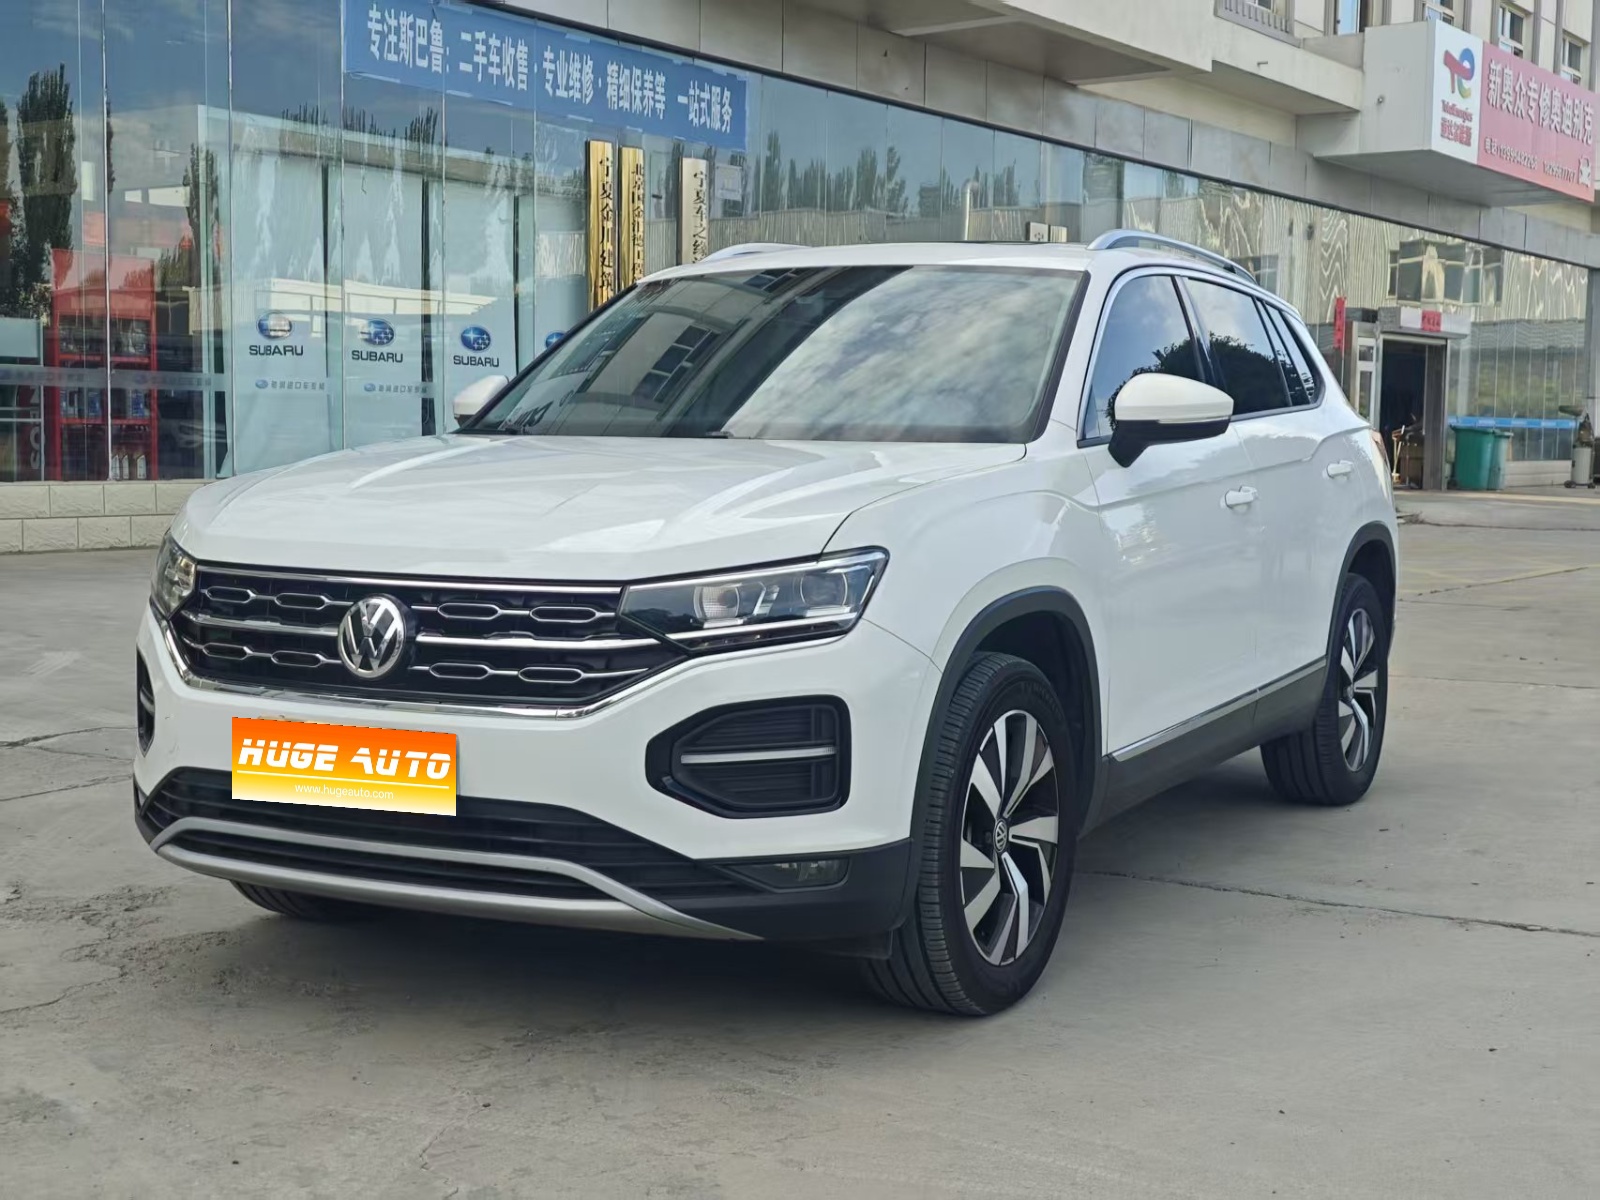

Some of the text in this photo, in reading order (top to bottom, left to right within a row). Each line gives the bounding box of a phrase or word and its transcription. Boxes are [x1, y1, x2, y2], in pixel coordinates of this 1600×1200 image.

[677, 80, 733, 133] 一站式服务
[249, 344, 304, 356] SUBARU
[351, 349, 403, 363] SUBARU
[453, 354, 500, 368] SUBARU
